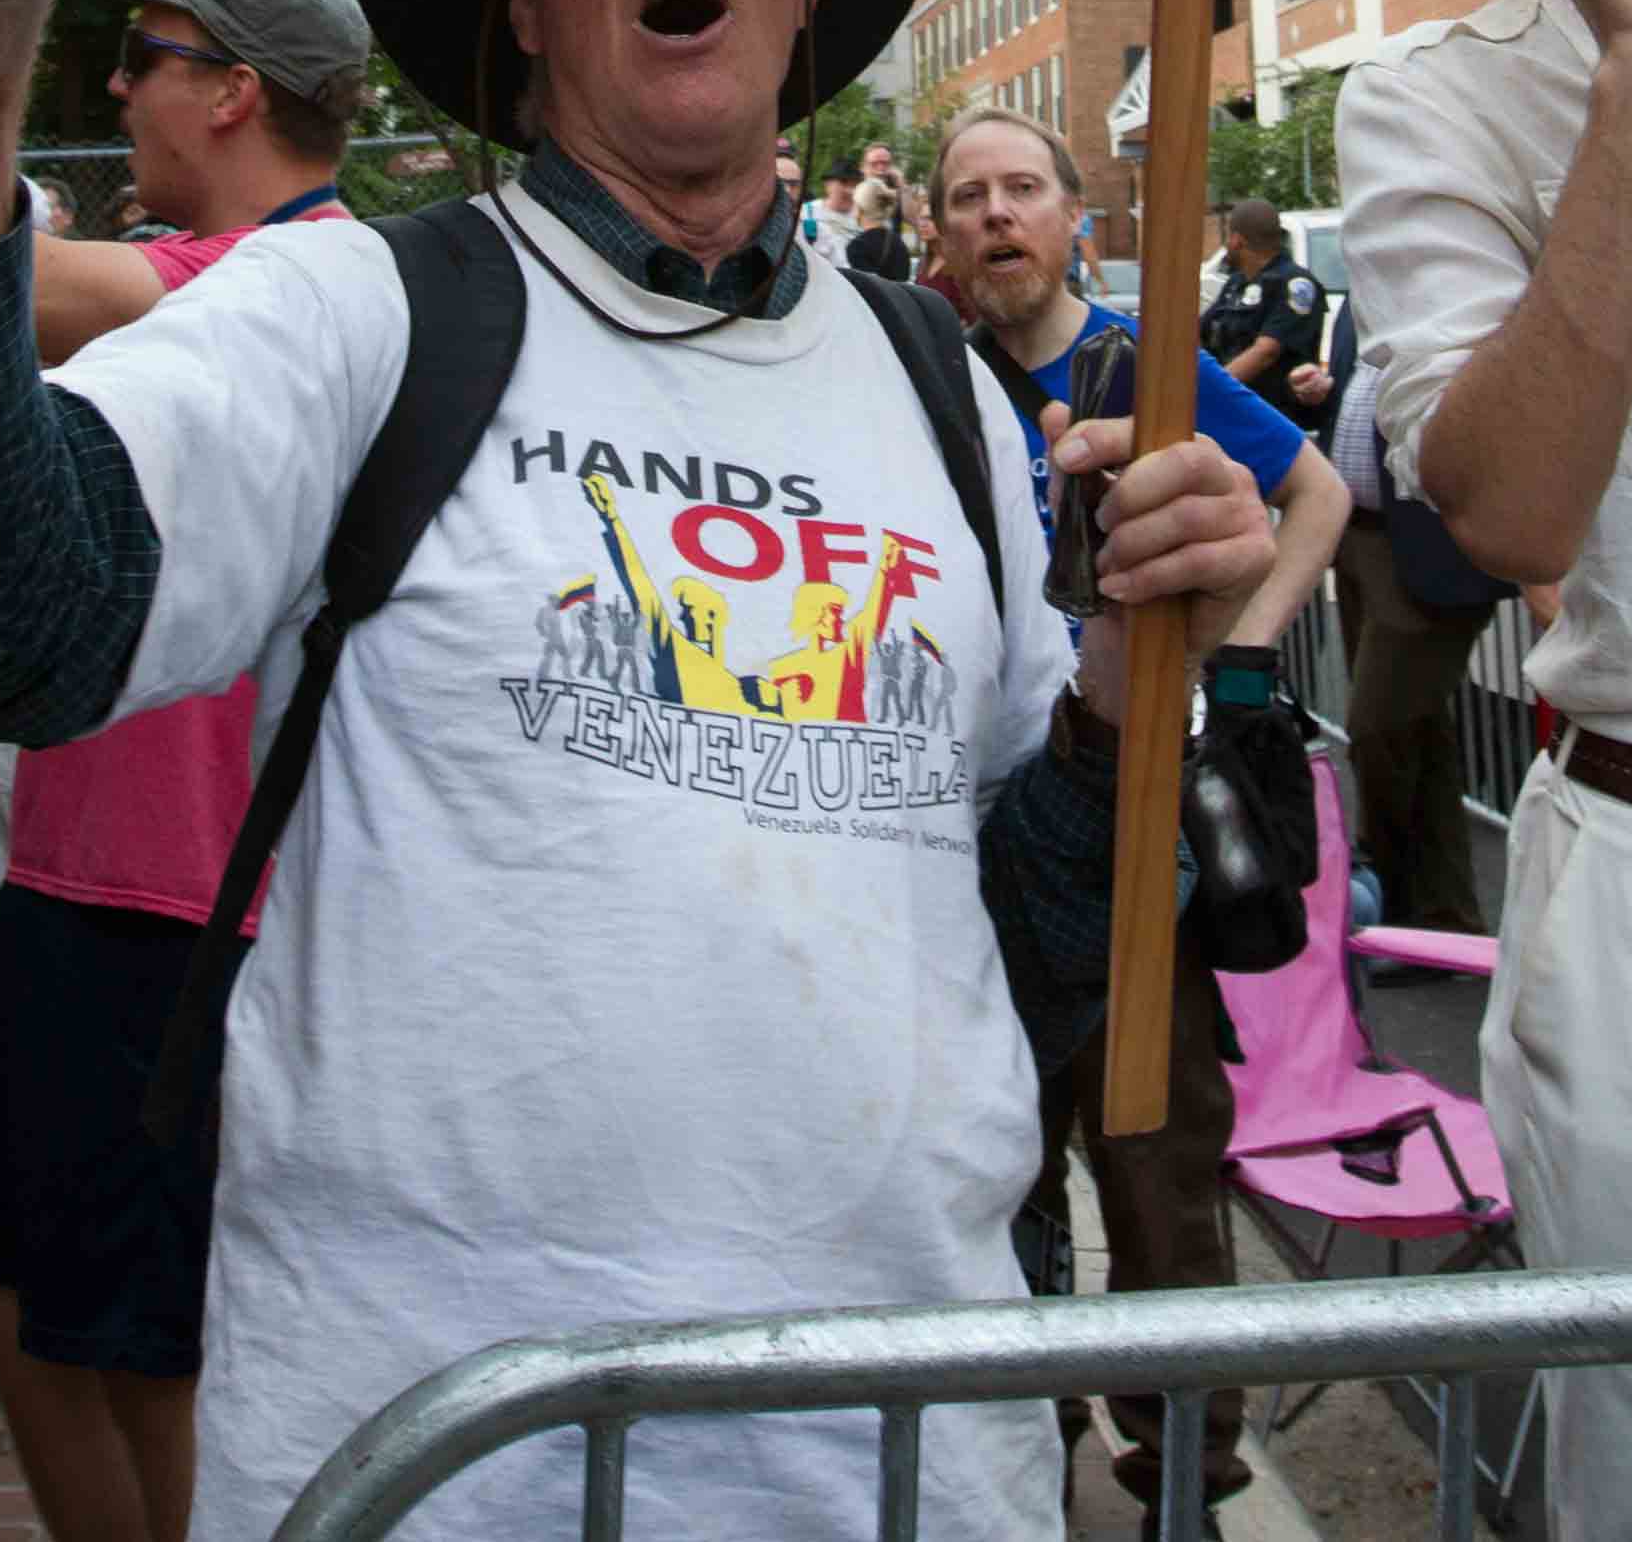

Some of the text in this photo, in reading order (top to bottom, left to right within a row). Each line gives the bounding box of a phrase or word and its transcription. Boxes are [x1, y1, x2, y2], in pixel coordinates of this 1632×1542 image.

[510, 429, 824, 518] HANDS
[670, 502, 943, 600] OFF
[742, 807, 843, 837] Venezuela
